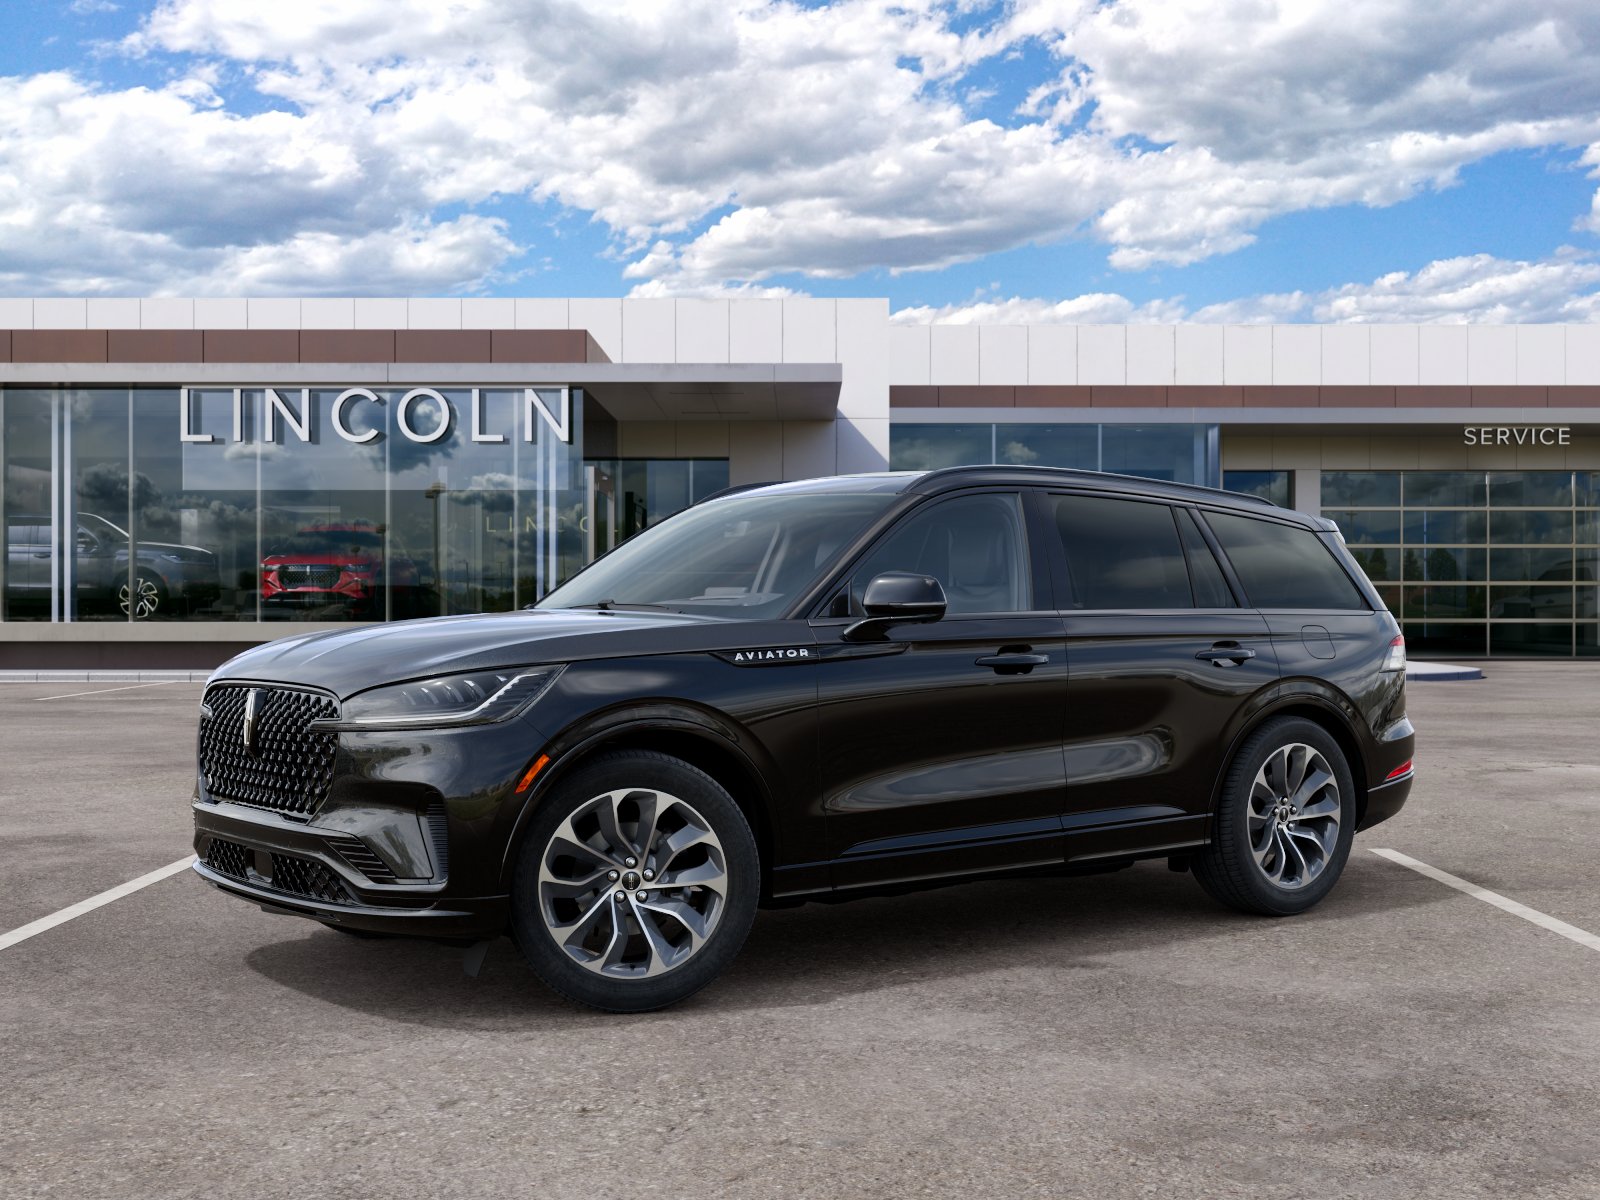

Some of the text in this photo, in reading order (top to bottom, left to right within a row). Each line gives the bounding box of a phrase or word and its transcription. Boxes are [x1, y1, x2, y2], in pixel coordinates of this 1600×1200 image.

[180, 388, 570, 443] LINCOLN
[1464, 427, 1571, 445] SERVICE
[734, 648, 809, 661] AVIATOR
